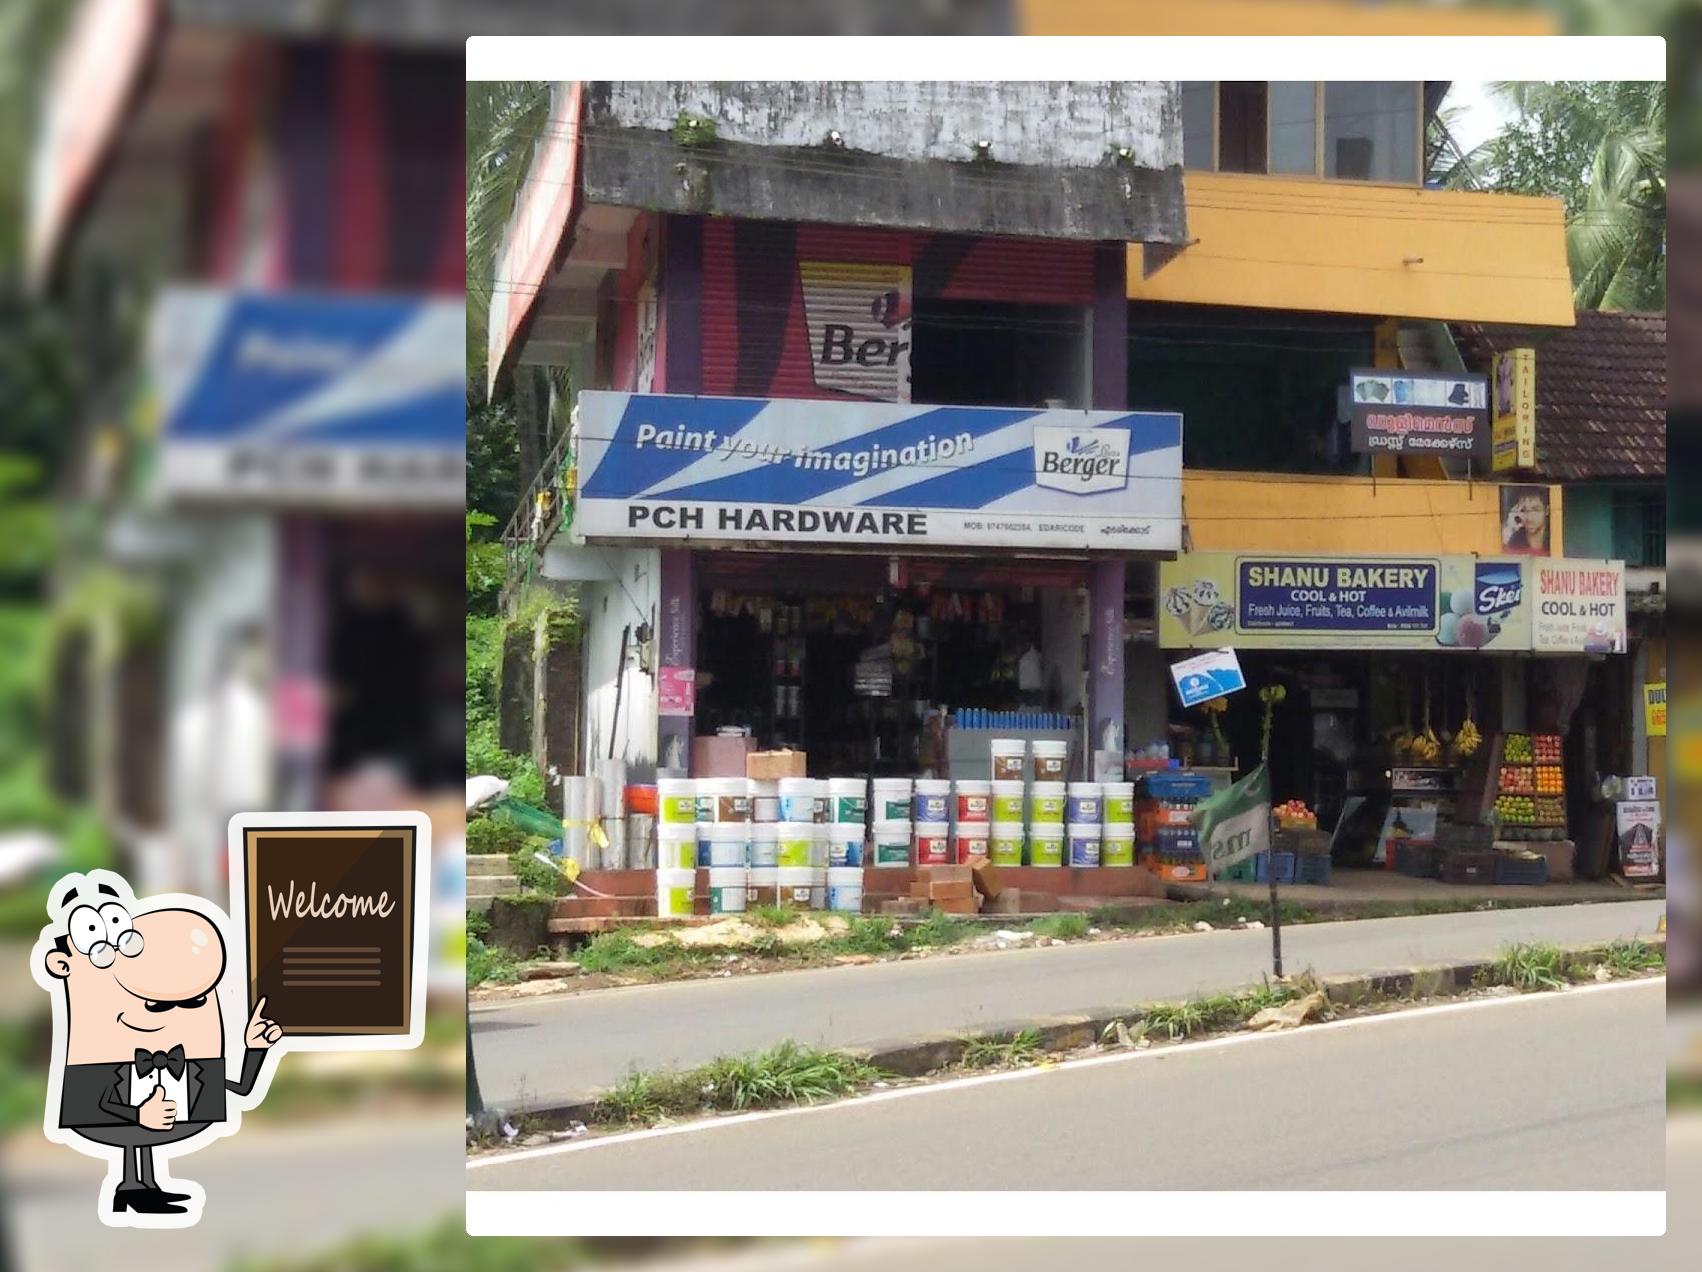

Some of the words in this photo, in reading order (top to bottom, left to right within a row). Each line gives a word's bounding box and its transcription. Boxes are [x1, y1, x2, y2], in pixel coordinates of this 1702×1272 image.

[821, 323, 910, 367] Ber
[636, 423, 716, 452] Paint
[720, 435, 792, 464] your
[794, 432, 973, 476] imagination
[1043, 451, 1120, 481] Berger
[628, 505, 704, 529] PCH
[718, 508, 928, 535] HARDWARE
[1249, 566, 1330, 587] SHANU
[1336, 568, 1429, 588] BAKERY
[1540, 570, 1575, 594] SHANU
[1579, 571, 1619, 596] BAKERY
[1290, 590, 1326, 602] COOL
[1328, 592, 1337, 602] &
[1339, 590, 1367, 602] HOT
[1541, 601, 1577, 616] COOL
[1579, 604, 1587, 616] &
[1589, 602, 1616, 617] HOT
[1248, 604, 1275, 617] Fresh
[1357, 604, 1386, 618] Coffee
